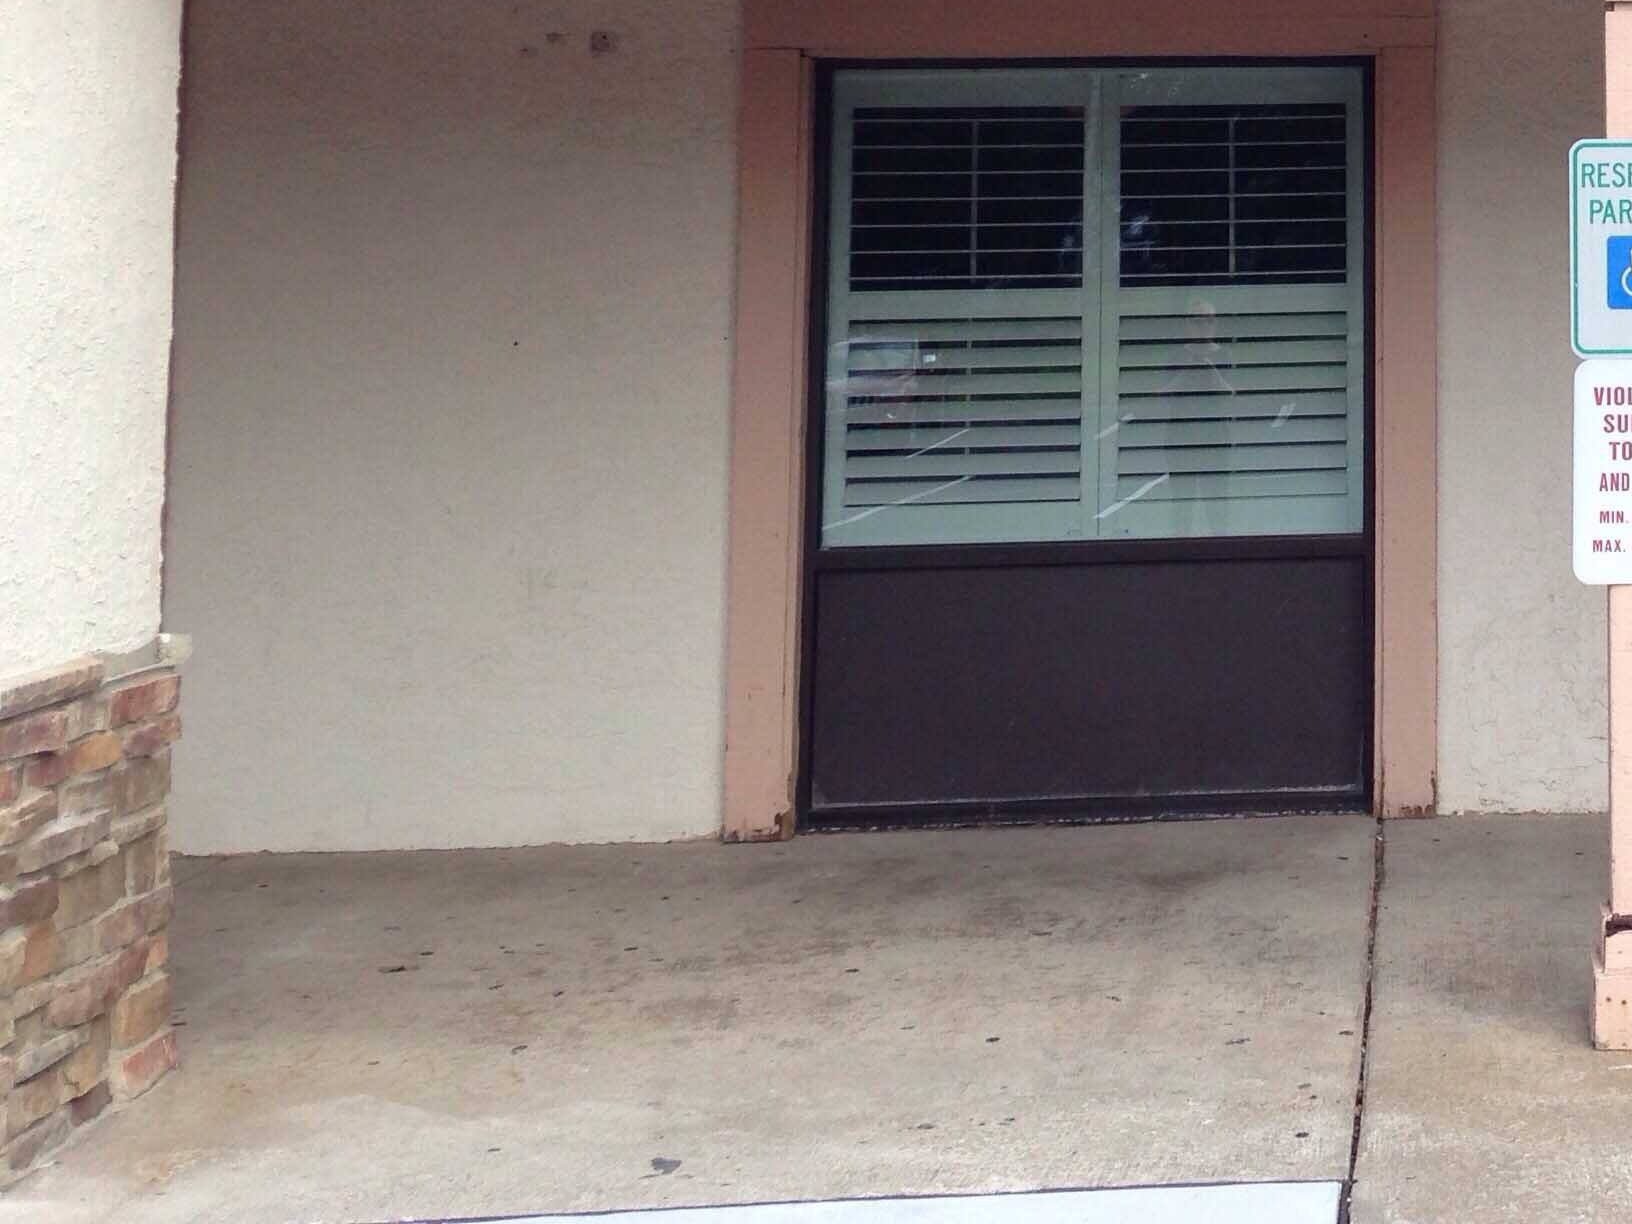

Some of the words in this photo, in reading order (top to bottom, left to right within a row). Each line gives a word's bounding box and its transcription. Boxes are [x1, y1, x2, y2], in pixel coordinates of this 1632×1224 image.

[1608, 440, 1632, 461] TO
[1599, 471, 1630, 492] AND
[1599, 509, 1630, 524] MIN.
[1592, 538, 1626, 553] MAX.
